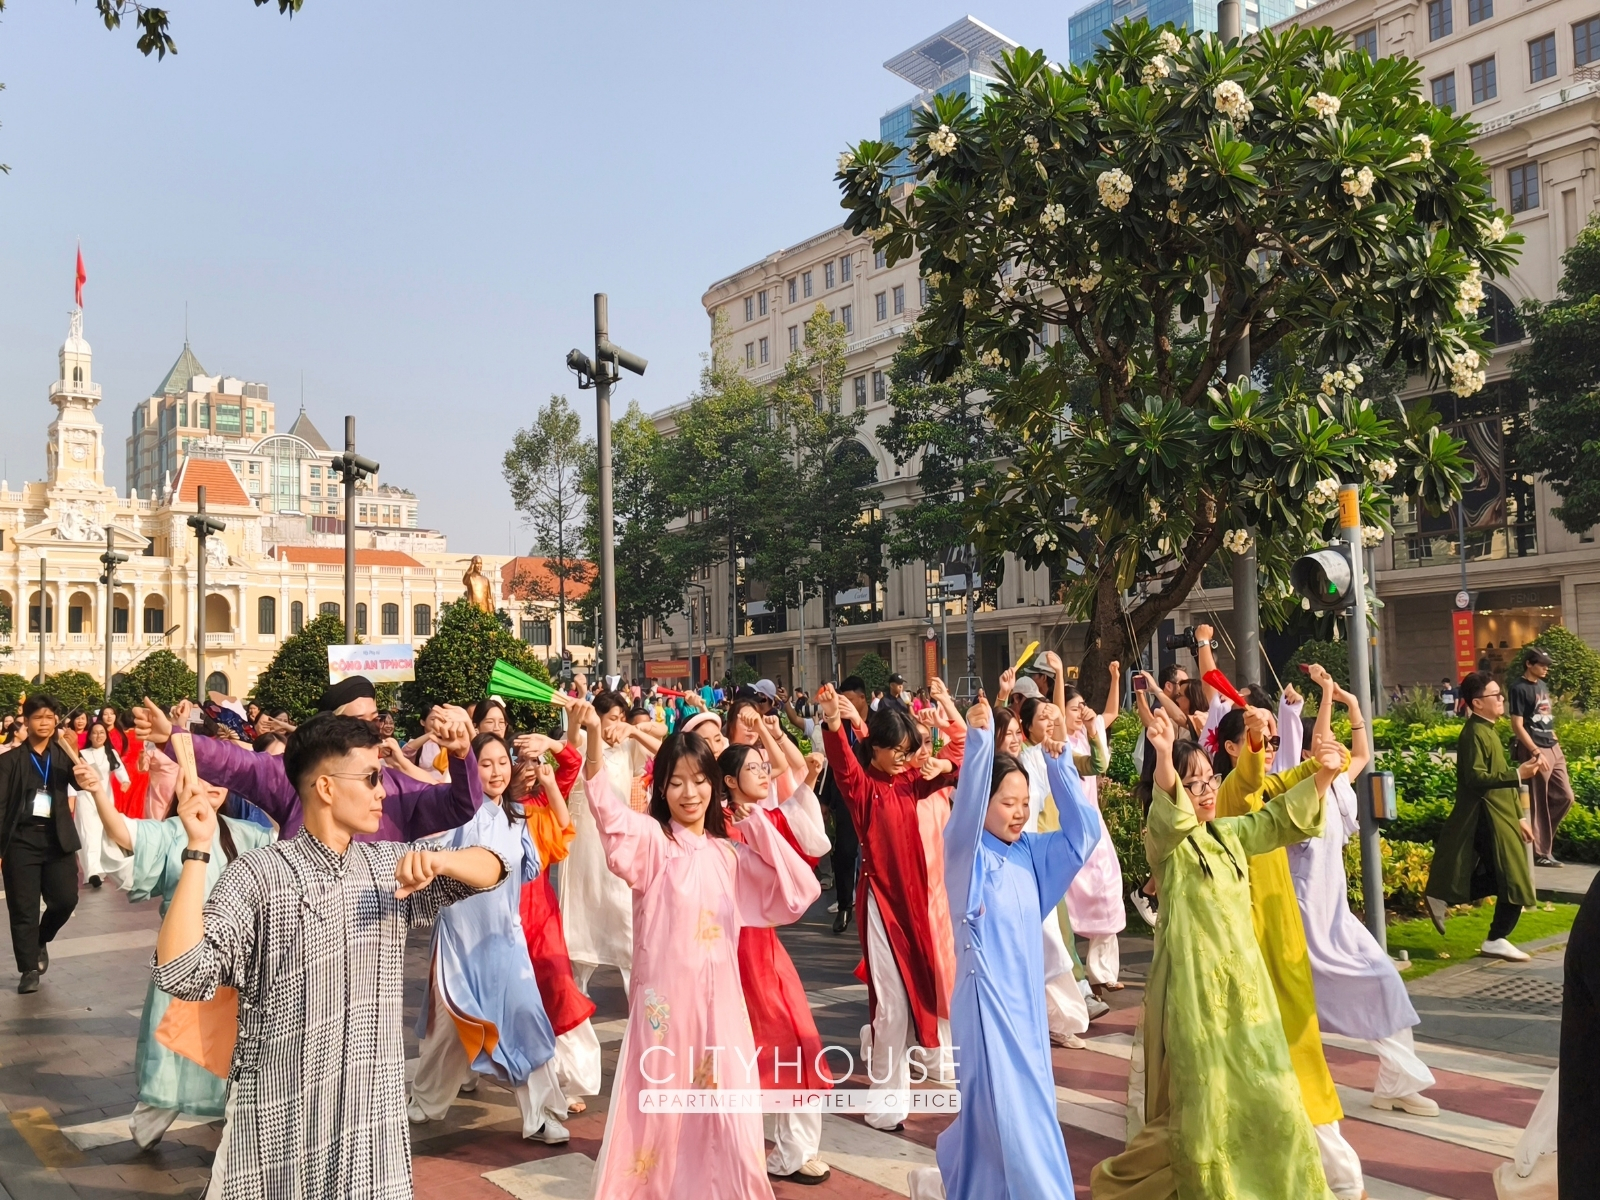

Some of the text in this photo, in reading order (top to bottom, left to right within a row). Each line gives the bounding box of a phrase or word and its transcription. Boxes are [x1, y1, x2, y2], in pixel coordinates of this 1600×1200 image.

[1509, 591, 1541, 604] FENDI
[331, 659, 413, 671] CÔNG AN TPHCM
